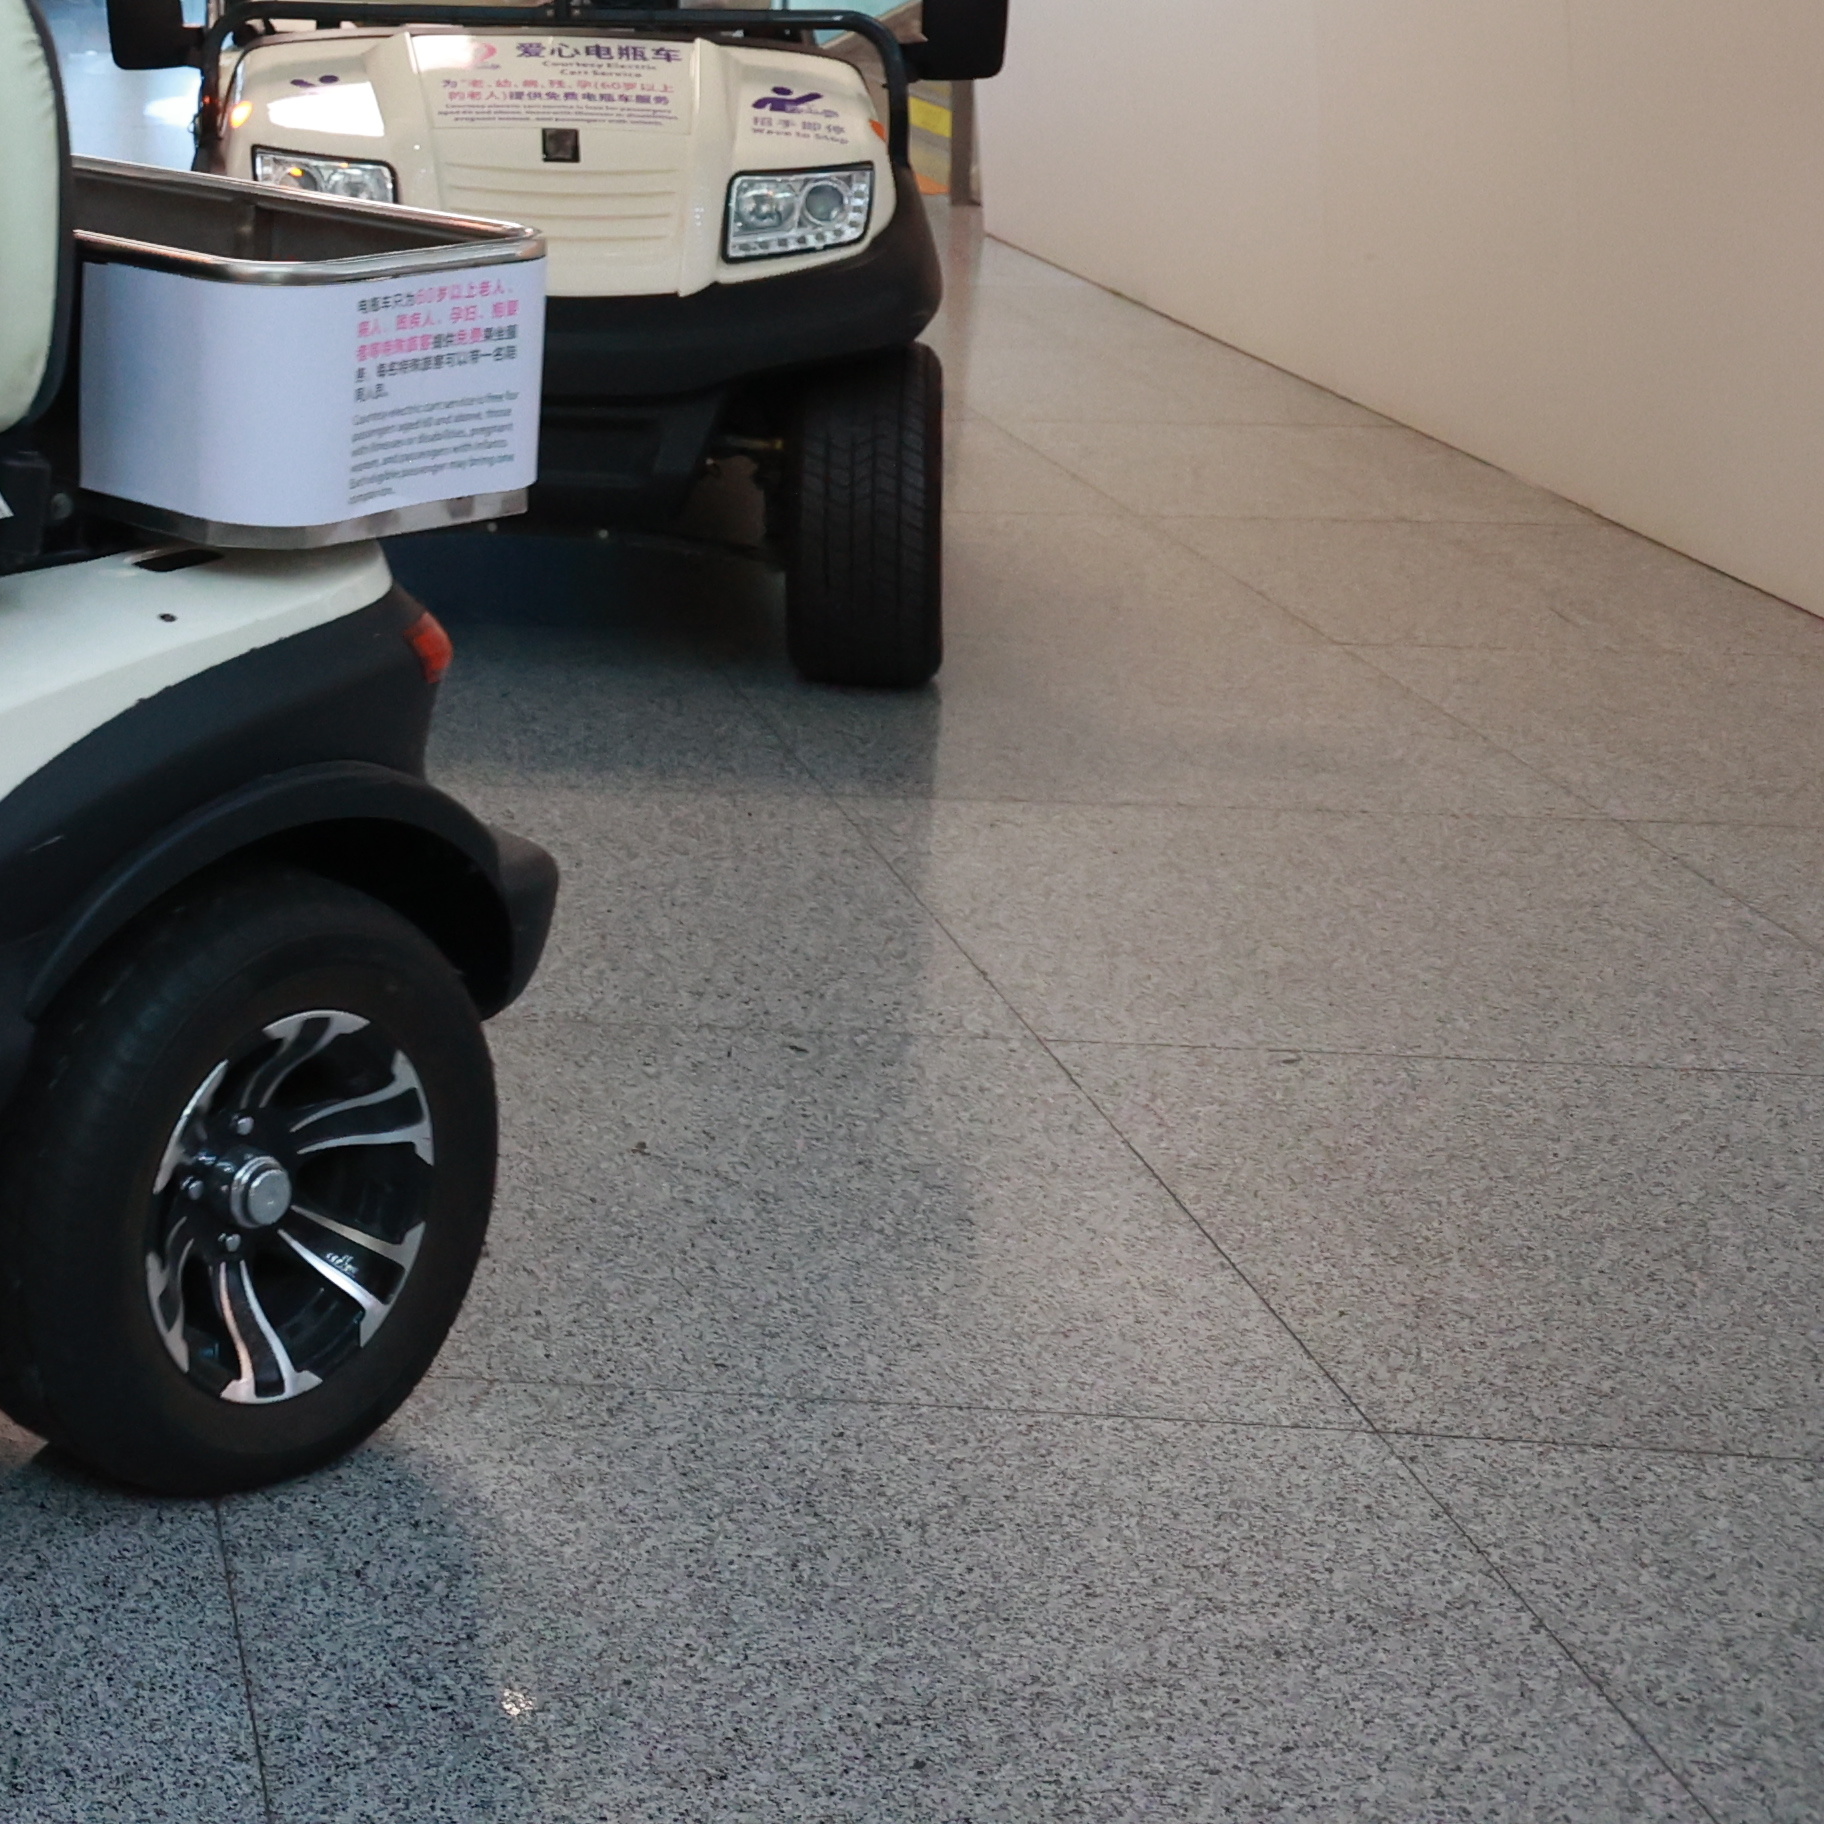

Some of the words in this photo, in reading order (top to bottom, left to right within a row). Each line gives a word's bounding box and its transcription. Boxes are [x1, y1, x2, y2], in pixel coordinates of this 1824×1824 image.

[516, 42, 683, 63] 爱心电瓶车
